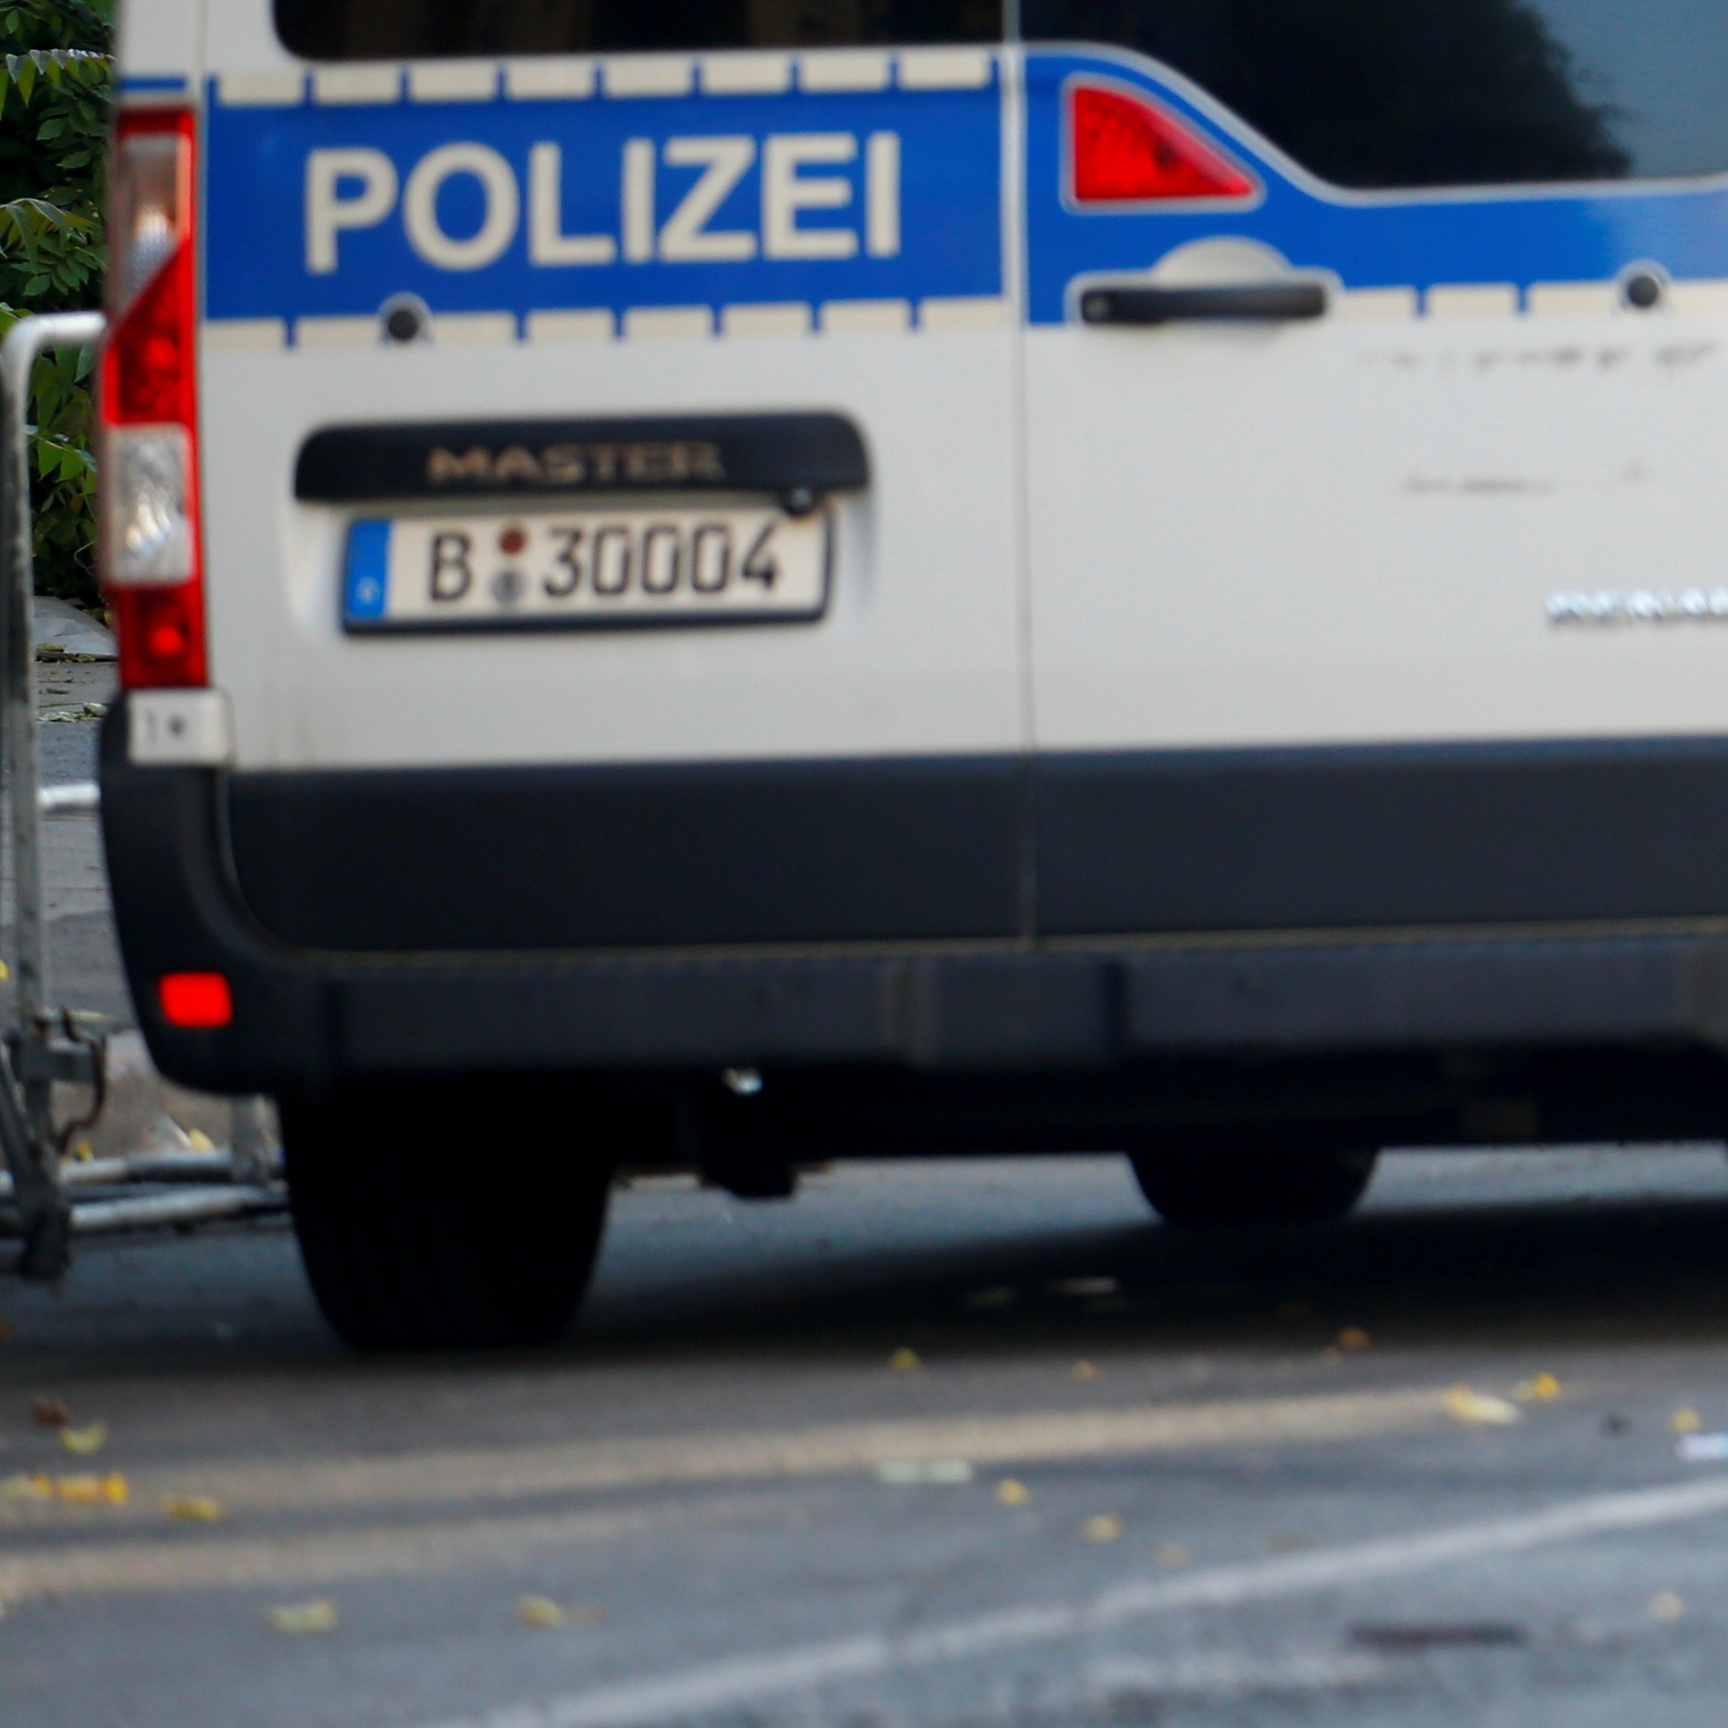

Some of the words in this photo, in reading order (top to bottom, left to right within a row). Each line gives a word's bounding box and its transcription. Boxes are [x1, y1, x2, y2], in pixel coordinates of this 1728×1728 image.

[305, 130, 901, 274] POLIZEI
[427, 438, 725, 486] MASTER
[429, 532, 473, 603] B
[543, 522, 780, 600] 30004
